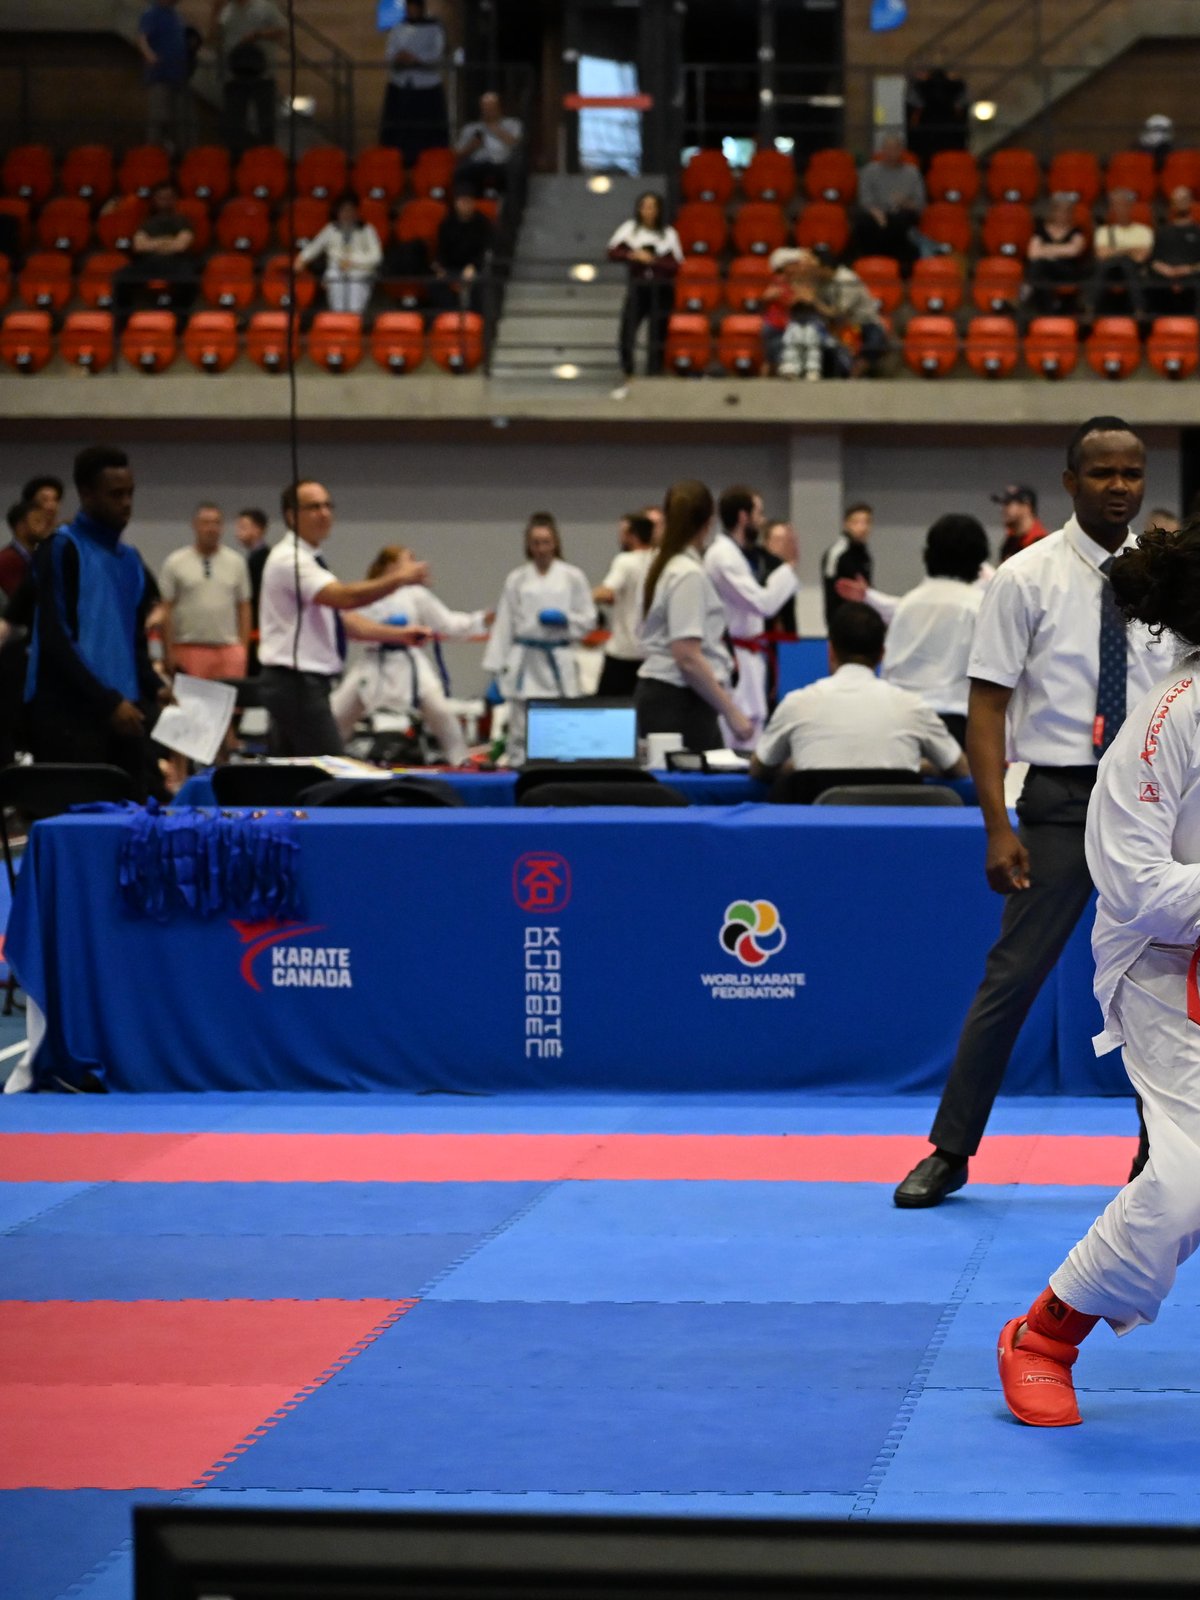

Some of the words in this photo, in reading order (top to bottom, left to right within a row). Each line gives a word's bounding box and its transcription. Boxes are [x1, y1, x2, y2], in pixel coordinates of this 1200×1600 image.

[1140, 677, 1193, 766] Arawaza
[272, 946, 351, 968] KARATE
[272, 967, 352, 988] CANADA
[700, 973, 752, 986] WORLD
[753, 973, 806, 986] KARATE
[712, 986, 795, 999] FEDERATION
